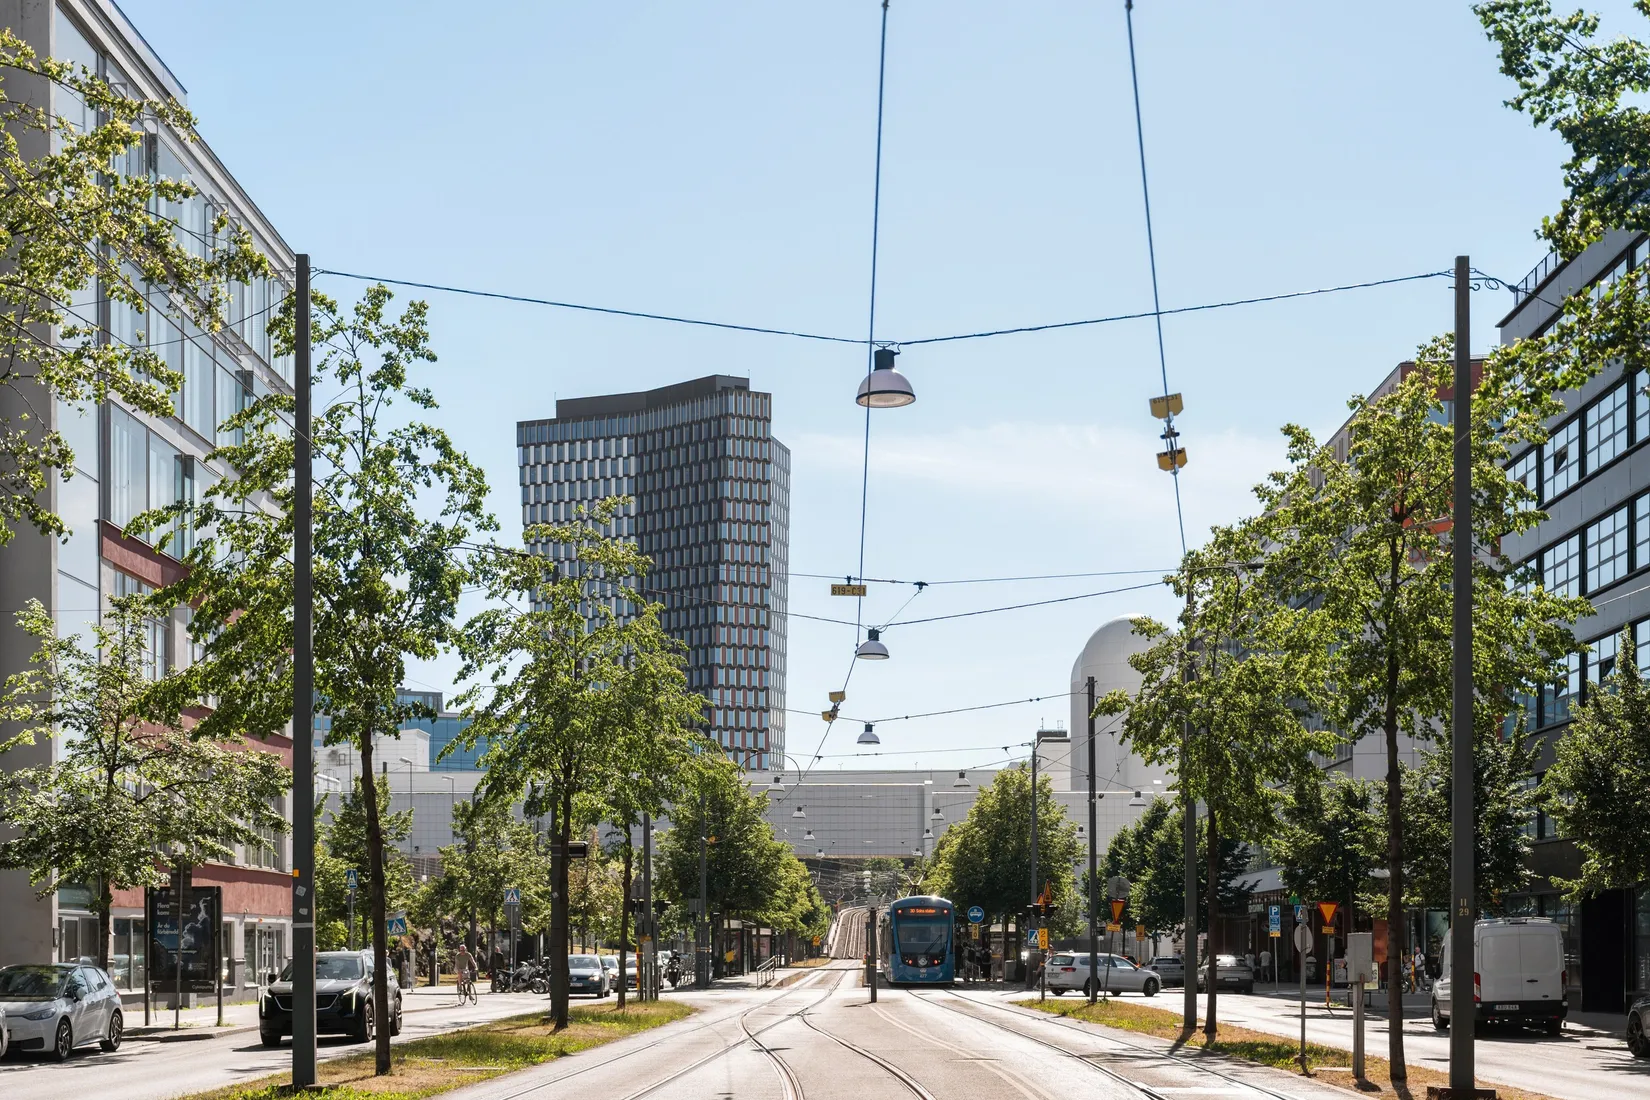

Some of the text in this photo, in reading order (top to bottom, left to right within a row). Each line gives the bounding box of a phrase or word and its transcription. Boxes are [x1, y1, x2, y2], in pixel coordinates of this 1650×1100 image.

[832, 587, 865, 595] 619-C31
[1271, 907, 1278, 916] P
[1458, 908, 1470, 917] 29
[1040, 930, 1046, 947] 20
